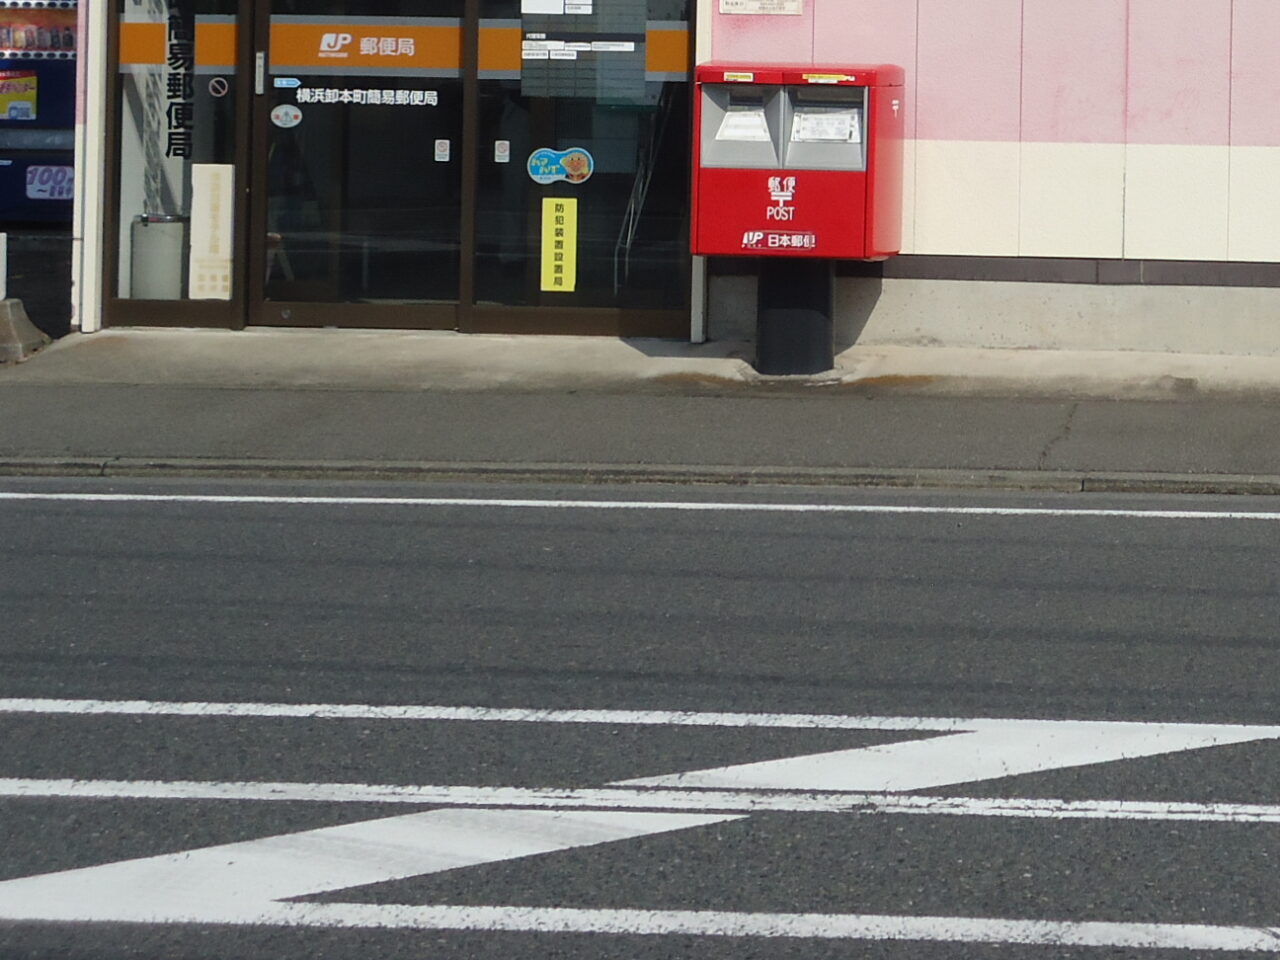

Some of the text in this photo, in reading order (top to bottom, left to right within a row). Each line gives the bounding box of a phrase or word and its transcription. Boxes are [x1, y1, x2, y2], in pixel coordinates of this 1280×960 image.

[360, 37, 415, 56] 郵便局
[296, 88, 438, 106] 横浜卸本町簡易郵便局
[768, 176, 796, 193] 郵便
[766, 207, 795, 221] POST
[768, 234, 816, 248] 日本郵便
